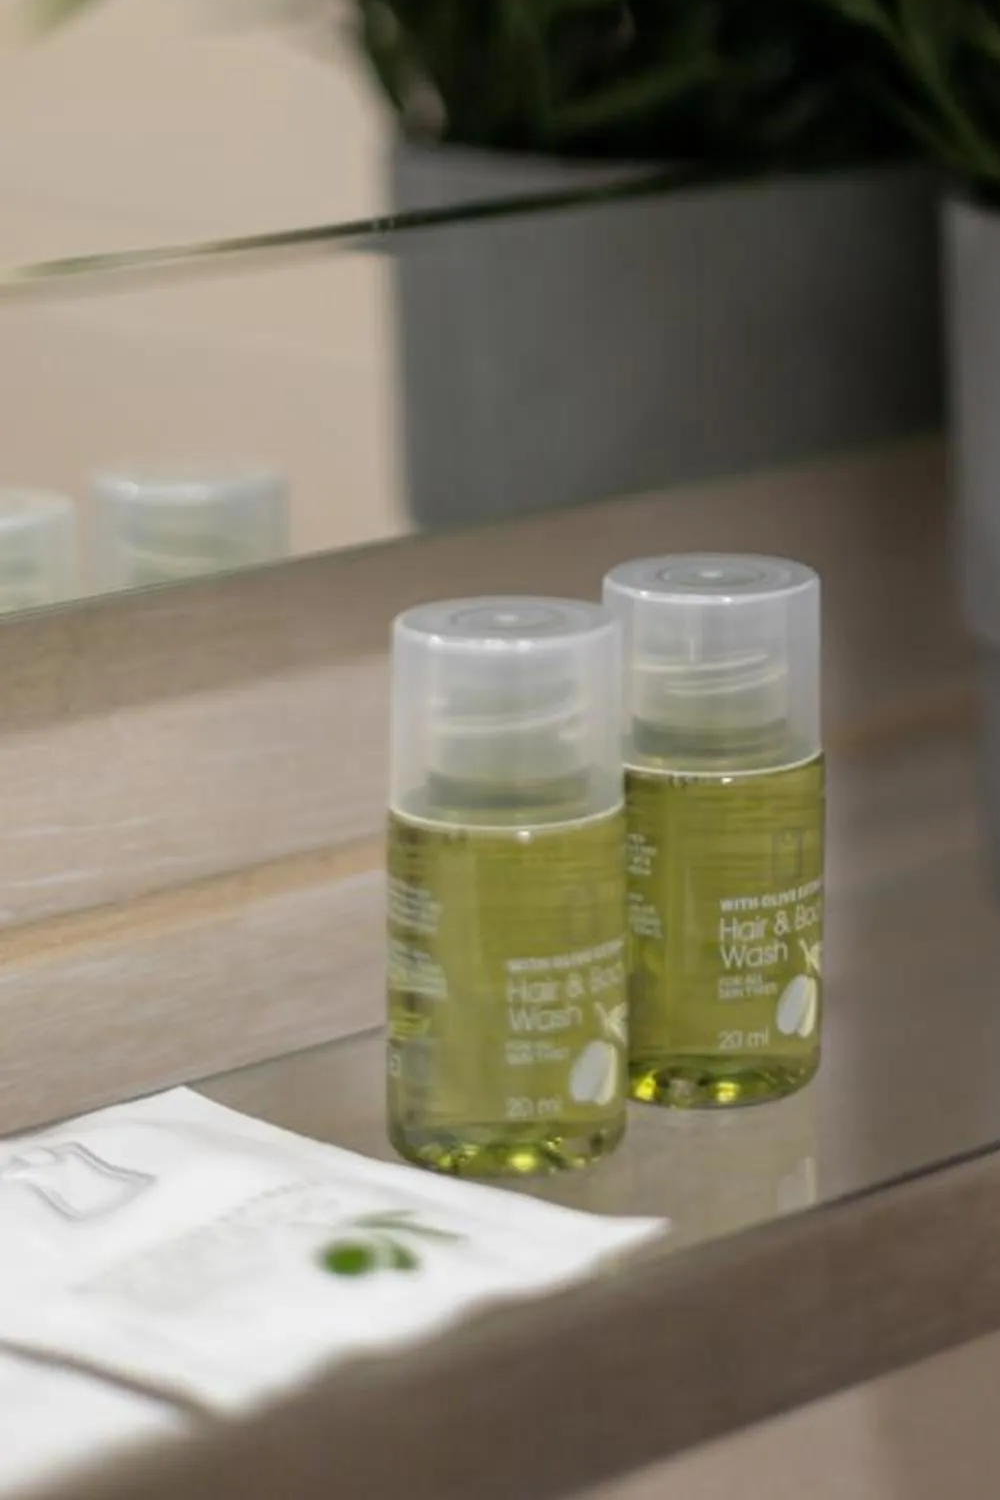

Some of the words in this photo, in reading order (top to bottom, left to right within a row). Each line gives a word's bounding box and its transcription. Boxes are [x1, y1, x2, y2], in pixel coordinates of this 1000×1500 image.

[719, 916, 768, 941] Hair
[773, 910, 790, 936] &
[719, 939, 788, 969] Wash
[507, 975, 558, 1002] Hair
[508, 1003, 583, 1032] Wash
[718, 1030, 744, 1050] 20
[747, 1026, 769, 1048] ml
